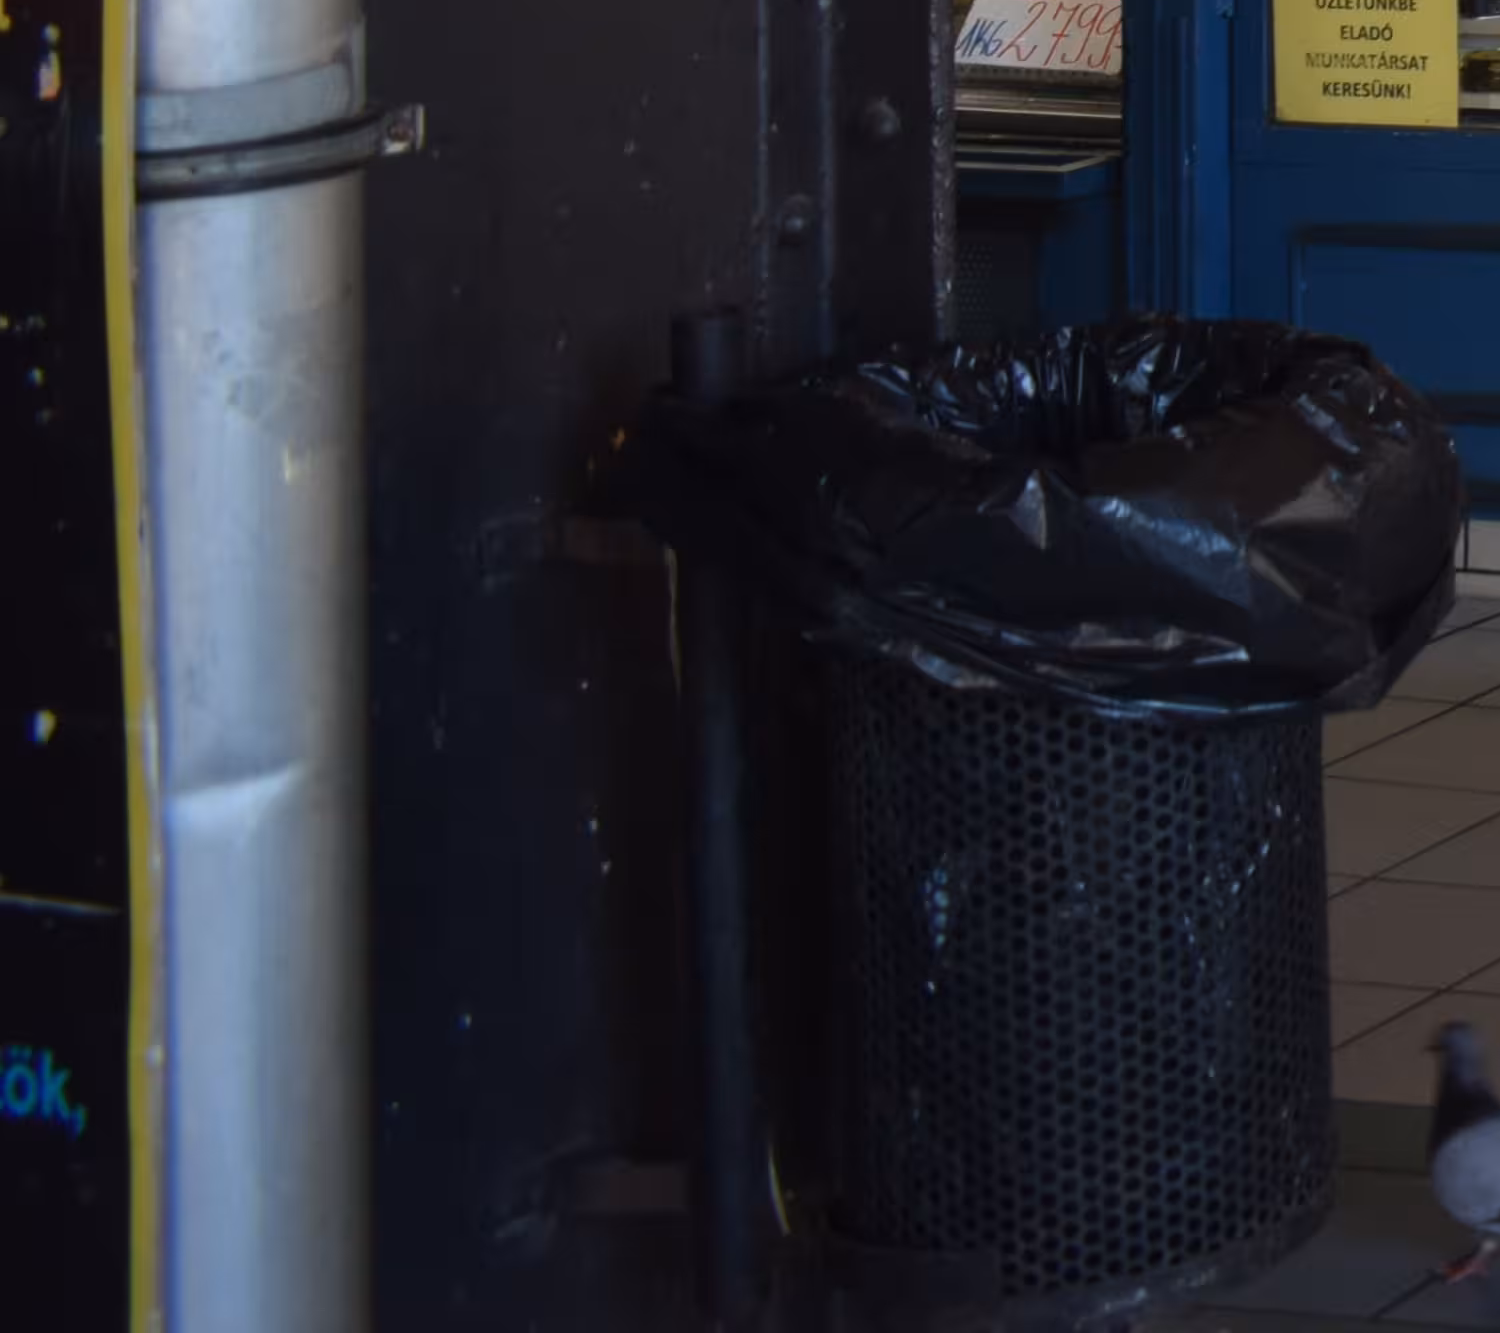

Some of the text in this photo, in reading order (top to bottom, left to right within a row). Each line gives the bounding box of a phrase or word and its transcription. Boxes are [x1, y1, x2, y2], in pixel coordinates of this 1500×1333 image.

[1340, 23, 1393, 41] ELADÓ
[1306, 51, 1428, 71] MUNKATÁRSAT
[1322, 80, 1411, 99] KERESÜNK!
[0, 1045, 90, 1141] ök,
